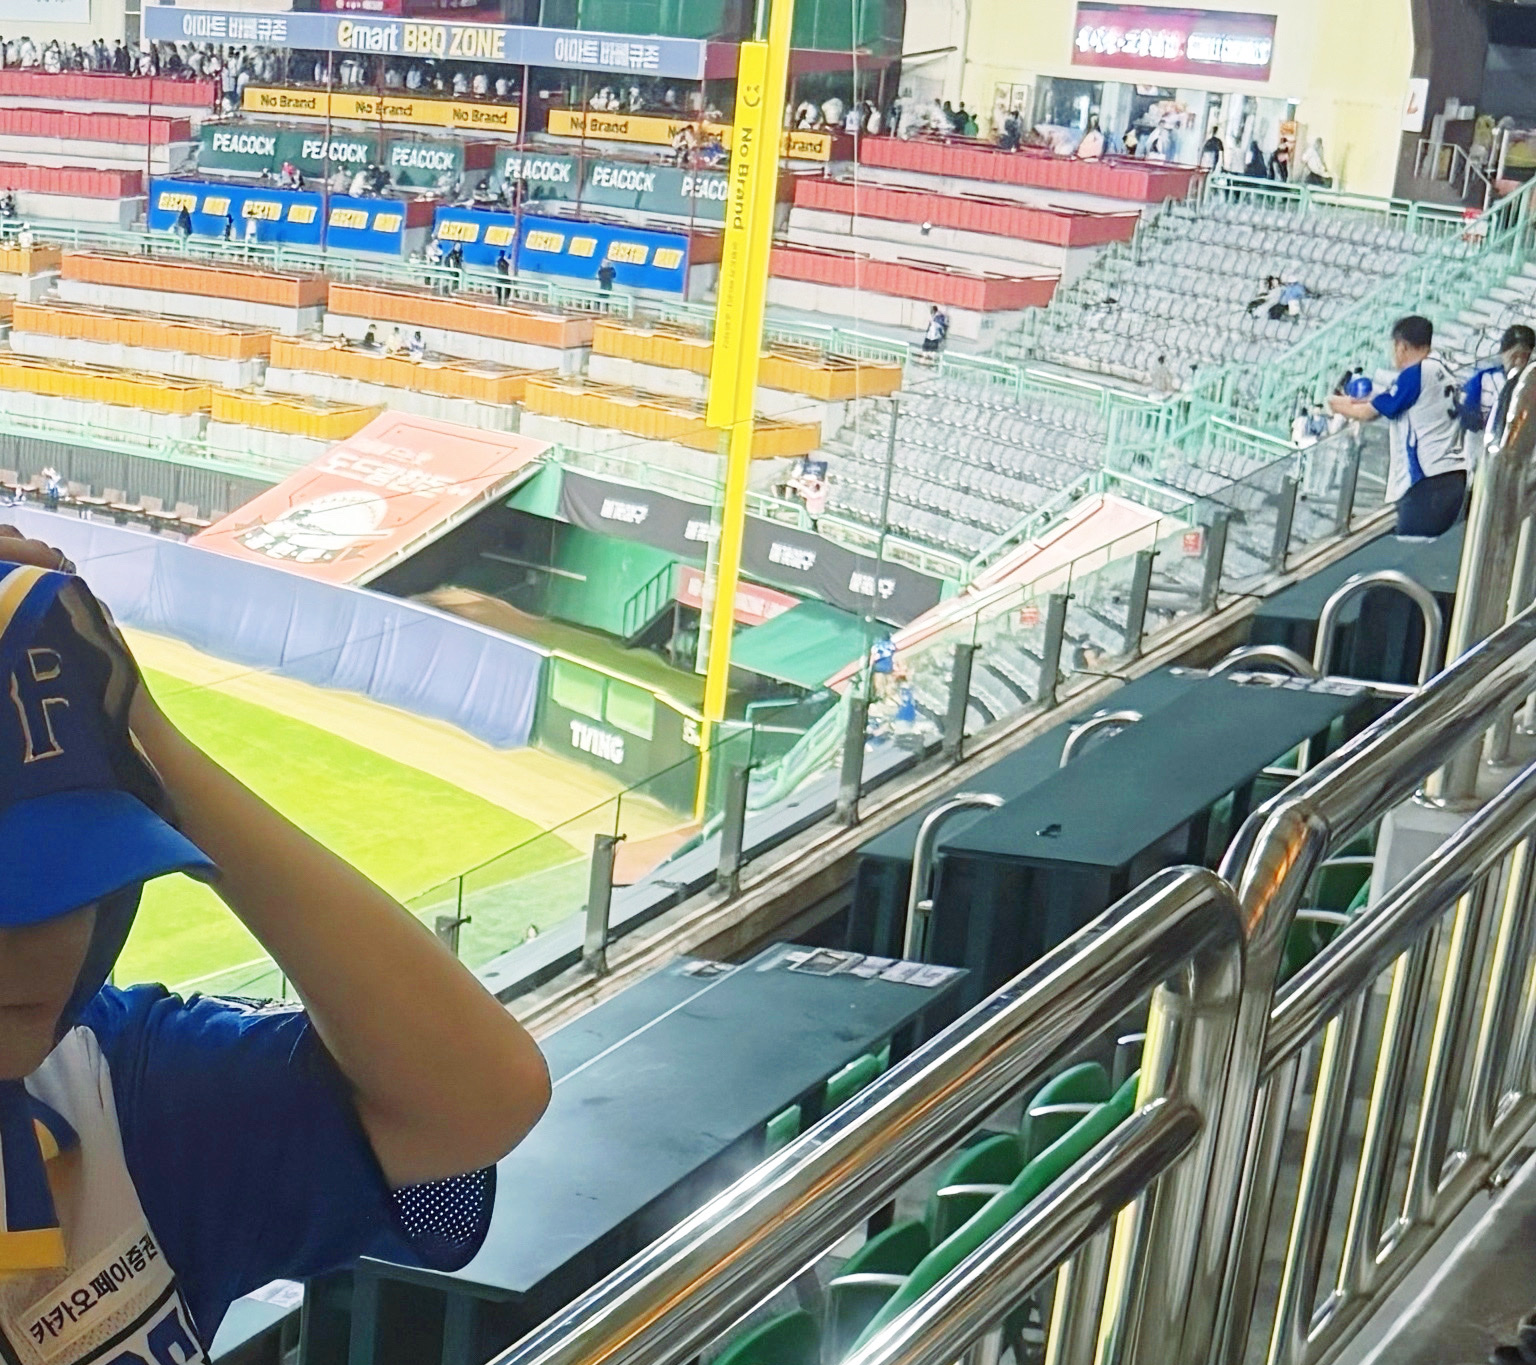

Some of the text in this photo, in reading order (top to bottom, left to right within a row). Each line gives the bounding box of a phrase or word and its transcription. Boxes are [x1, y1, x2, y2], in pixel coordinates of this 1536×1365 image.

[183, 13, 226, 37] 이마트
[338, 20, 507, 59] emart BBQ ZONE
[554, 37, 598, 64] 이마트
[260, 94, 316, 109] No Brand
[590, 118, 628, 134] Brand
[212, 133, 276, 156] PEACOCK
[391, 147, 455, 170] PEACOCK
[592, 166, 656, 192] PEACOCK
[733, 163, 750, 230] Brand
[570, 720, 624, 764] TVING
[29, 1232, 158, 1345] 카카오페이증권
